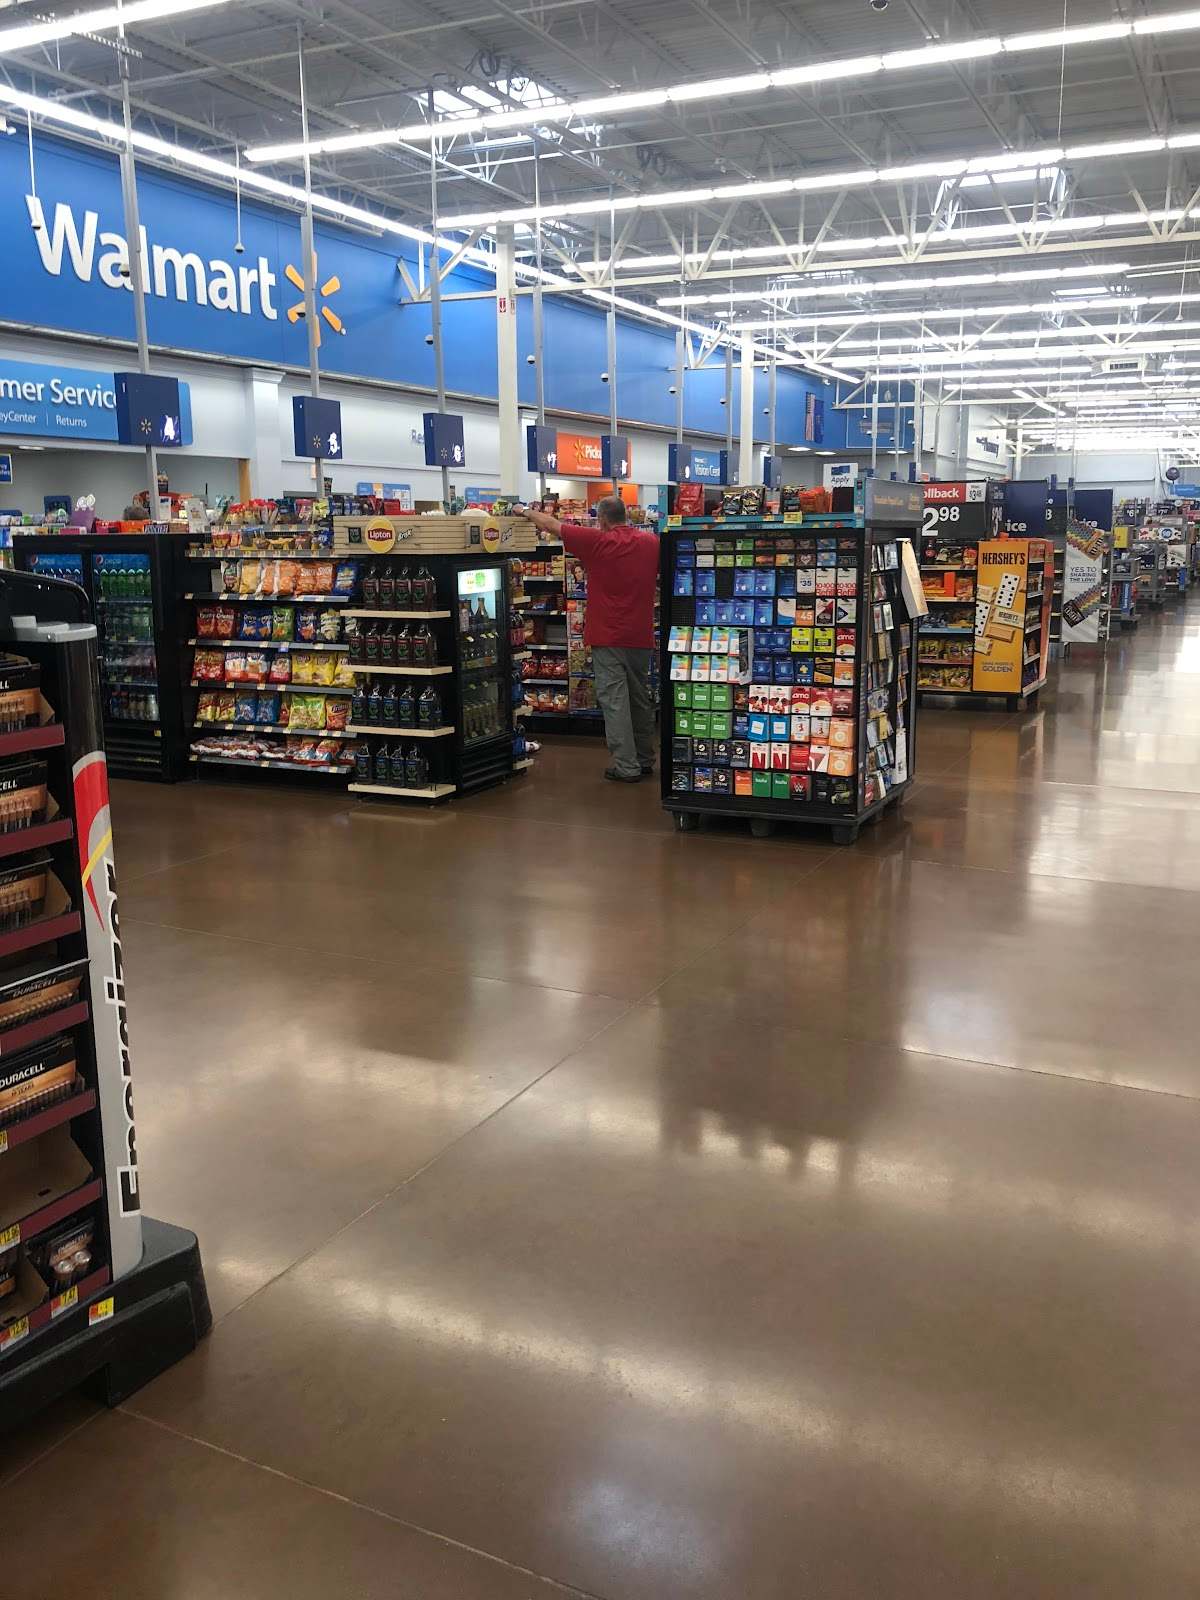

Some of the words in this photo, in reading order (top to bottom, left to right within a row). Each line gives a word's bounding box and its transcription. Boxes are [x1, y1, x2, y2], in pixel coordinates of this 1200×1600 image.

[25, 194, 278, 321] Walmart
[56, 414, 88, 428] Returns
[831, 476, 850, 487] Apply
[369, 530, 391, 541] Lipton
[484, 529, 499, 541] Lipton
[982, 552, 1026, 565] HERSHEY'S
